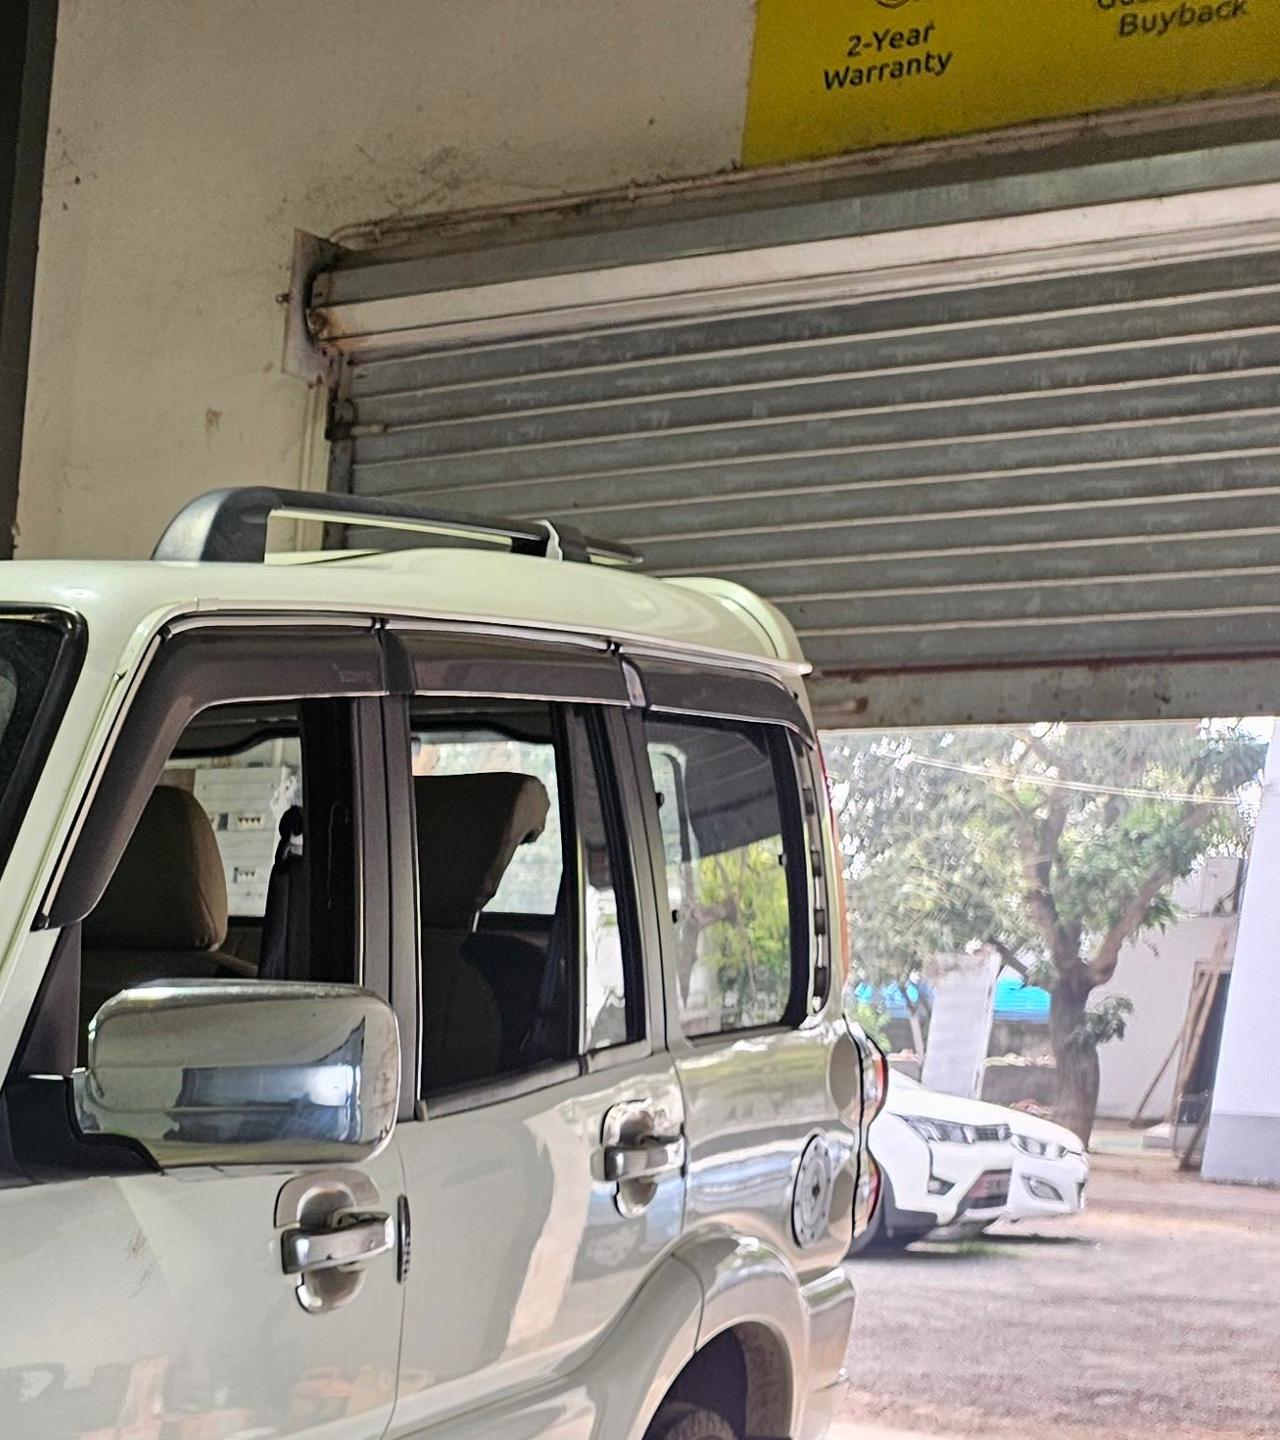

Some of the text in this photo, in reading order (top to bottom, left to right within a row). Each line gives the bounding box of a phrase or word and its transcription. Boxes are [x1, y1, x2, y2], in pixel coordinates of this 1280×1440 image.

[1117, 0, 1247, 38] Buyback
[846, 20, 935, 58] 2-Year
[823, 50, 953, 91] Warranty
